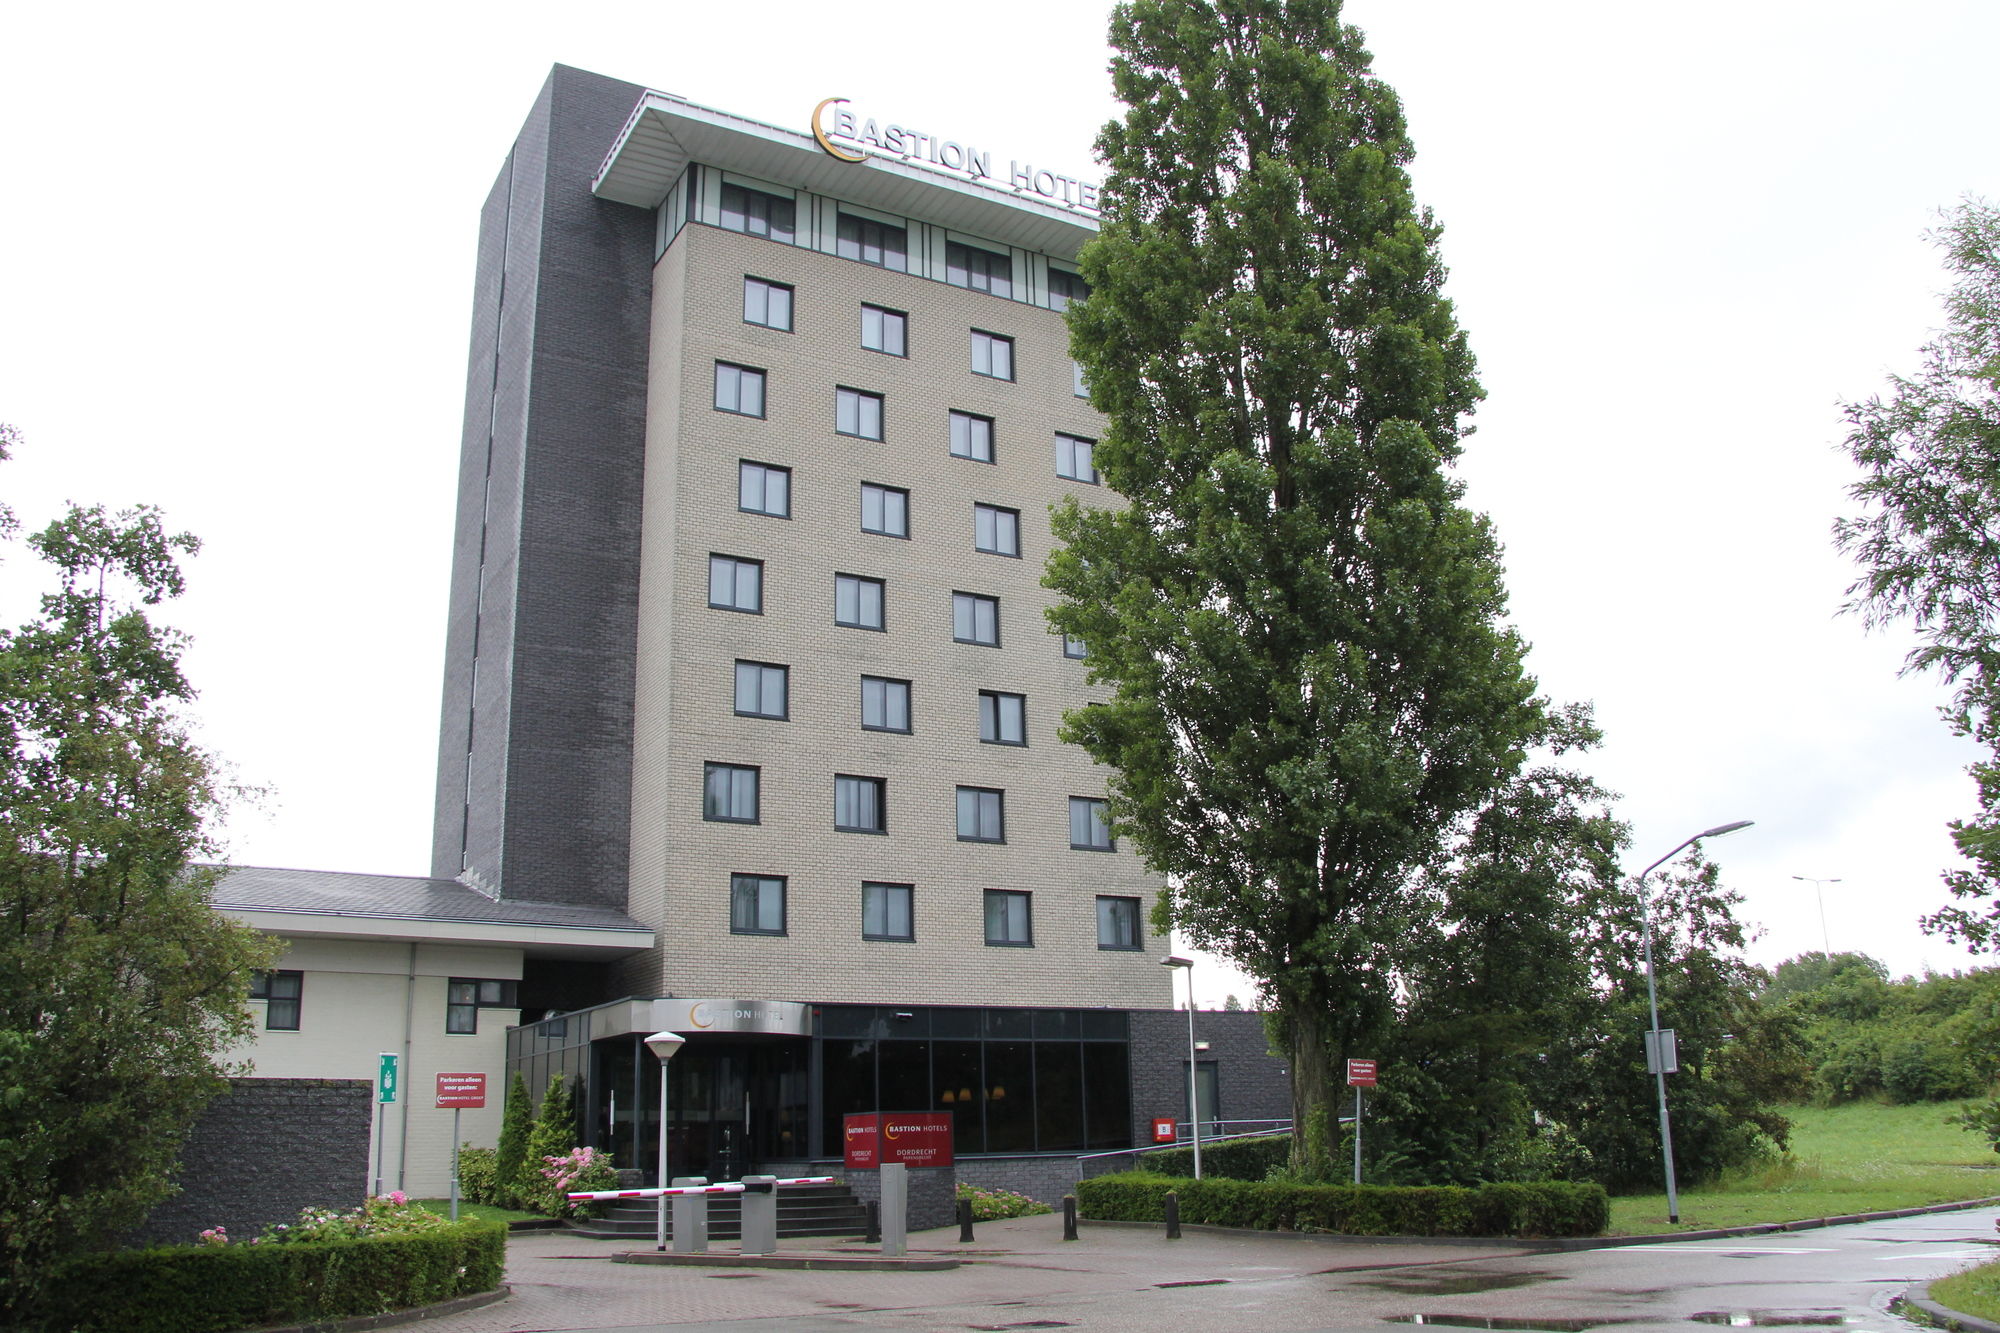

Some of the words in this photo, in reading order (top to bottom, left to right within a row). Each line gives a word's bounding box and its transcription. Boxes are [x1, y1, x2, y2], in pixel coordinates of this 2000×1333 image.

[834, 108, 991, 178] BASTION
[1010, 160, 1099, 211] HOTE
[896, 1148, 937, 1156] DORDRECHT
